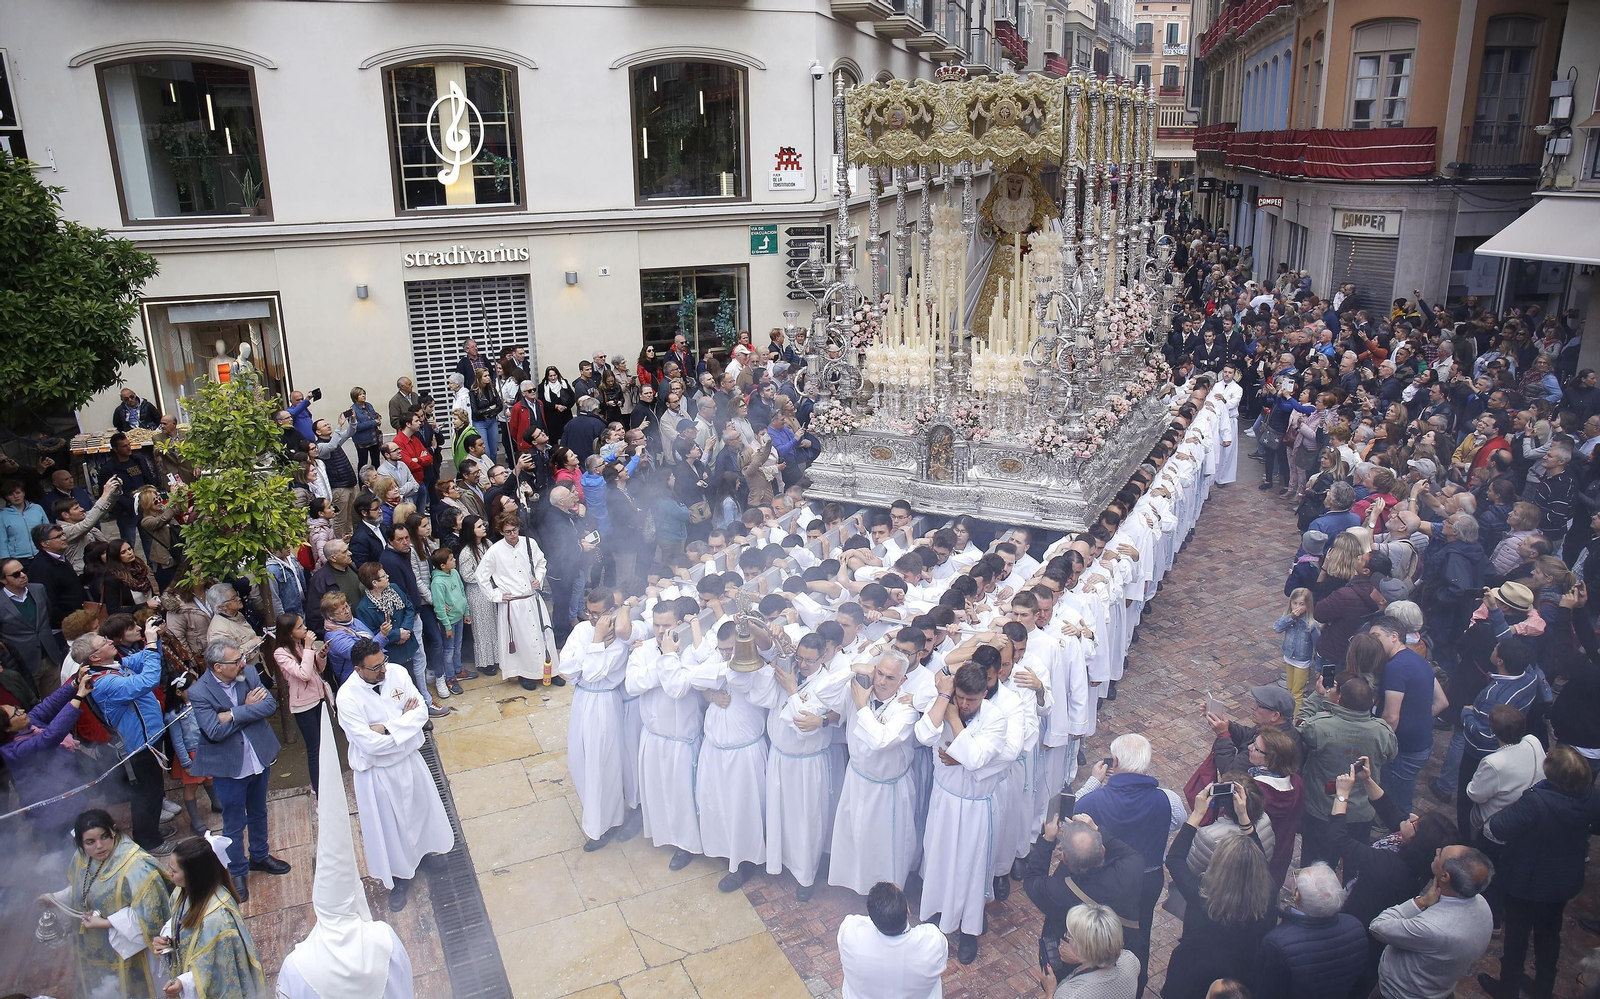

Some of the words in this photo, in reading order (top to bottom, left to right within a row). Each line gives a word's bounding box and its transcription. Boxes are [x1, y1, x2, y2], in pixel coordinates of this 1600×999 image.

[1258, 198, 1282, 207] CAMPER
[1342, 212, 1386, 232] CAMPER
[404, 242, 530, 268] stradivarius
